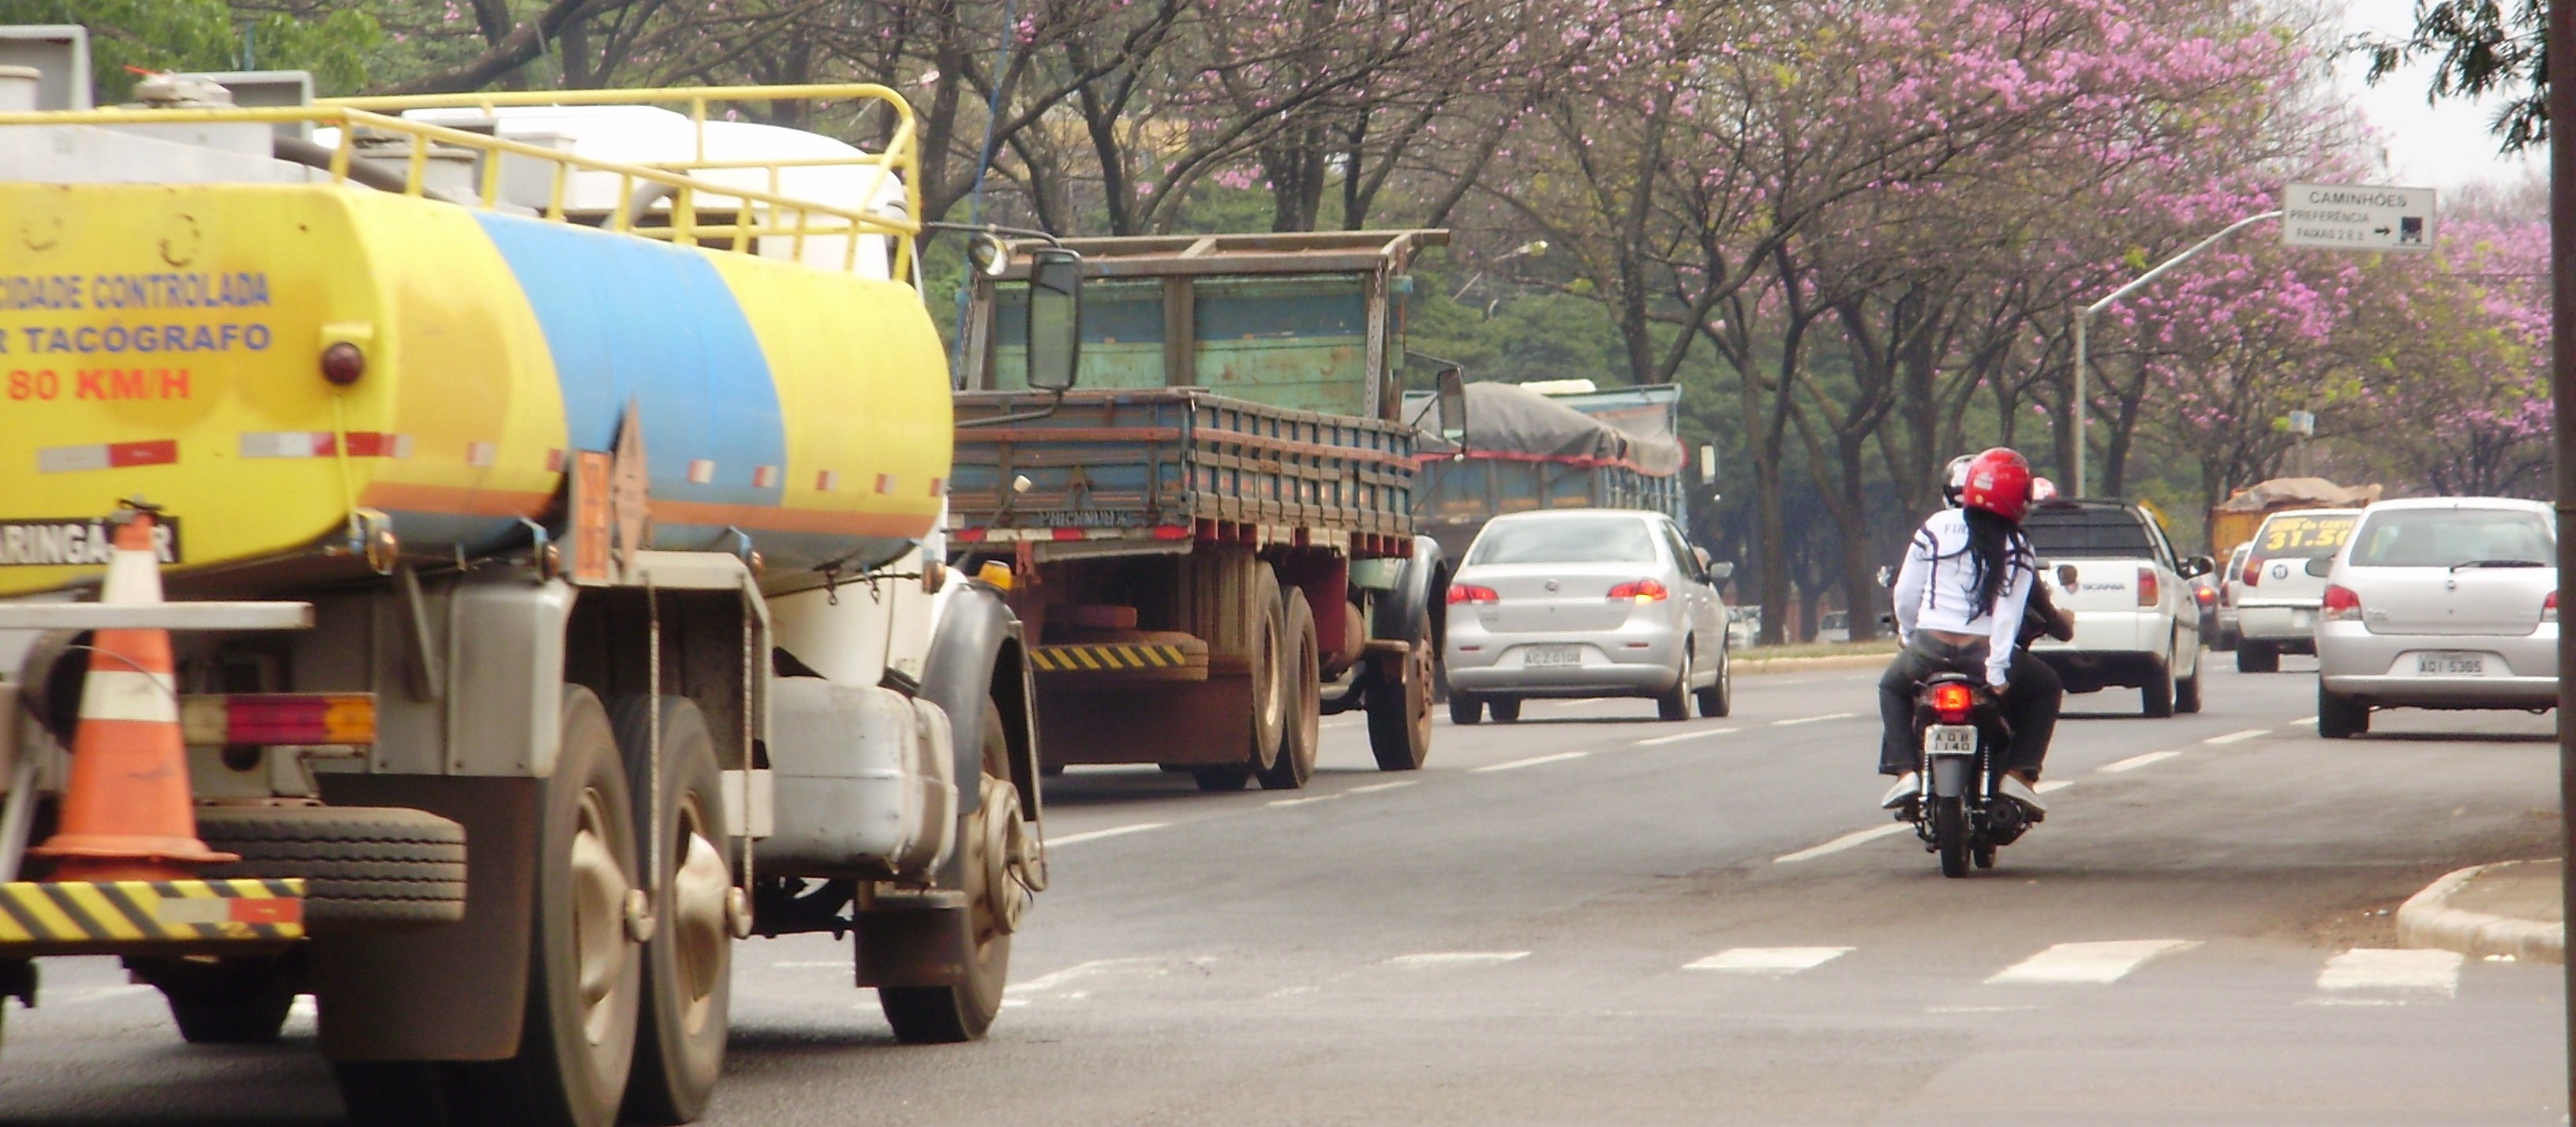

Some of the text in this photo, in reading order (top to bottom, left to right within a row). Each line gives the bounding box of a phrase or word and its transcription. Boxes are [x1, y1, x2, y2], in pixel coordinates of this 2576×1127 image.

[2309, 190, 2407, 207] CAMINHÕES
[2297, 227, 2334, 240] FAIXAS
[2338, 230, 2344, 240] 2
[91, 272, 272, 309] CONTROLADA
[23, 319, 271, 353] TACÓGRAFO
[9, 368, 191, 401] 80 KM/H
